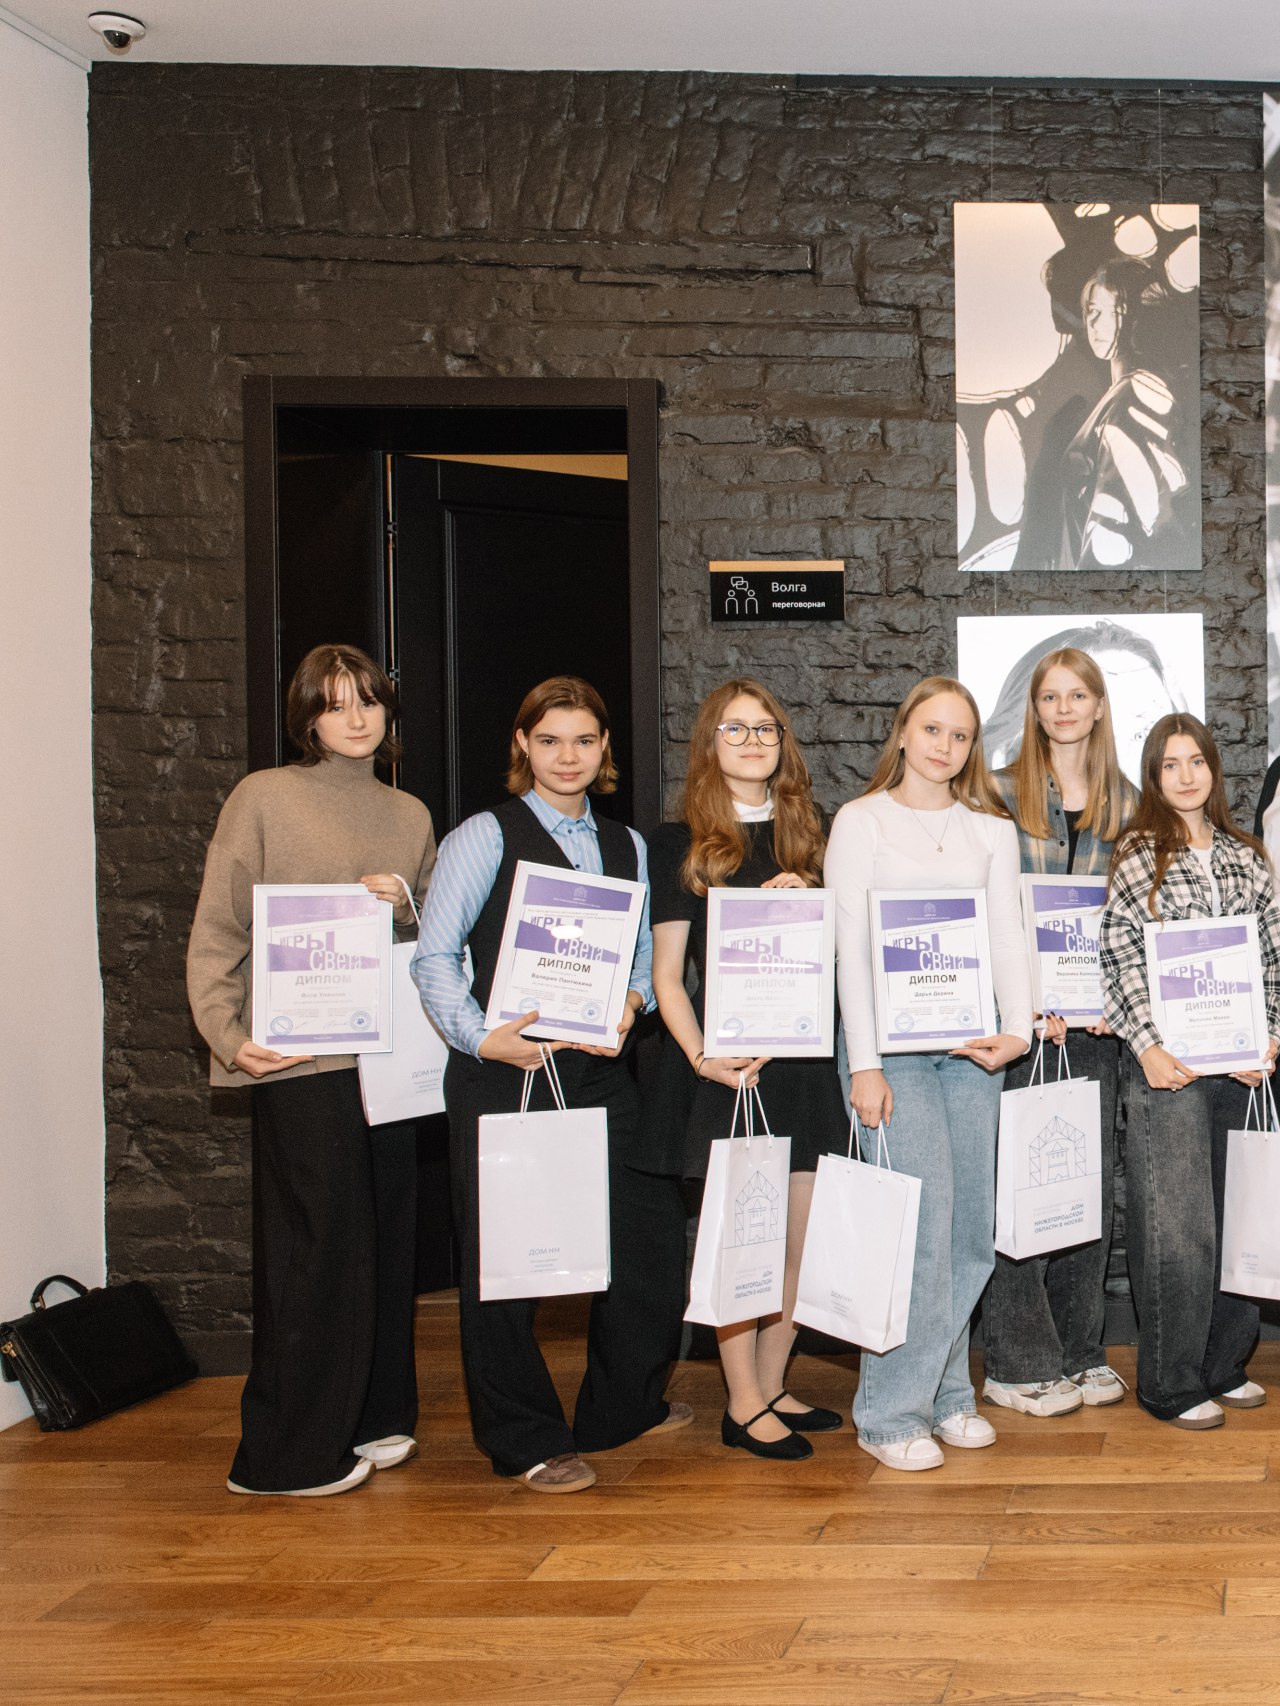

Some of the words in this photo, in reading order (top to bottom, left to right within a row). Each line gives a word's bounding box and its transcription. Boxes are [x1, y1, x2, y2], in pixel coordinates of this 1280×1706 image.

[771, 582, 807, 593] Волга
[772, 601, 826, 609] переговорная
[1042, 918, 1083, 936] ИГРЫ
[280, 931, 335, 951] ИГРЫ
[731, 936, 781, 955] ИГРЫ
[892, 933, 940, 953] ИГРЫ
[537, 957, 591, 974] ДИПЛОМ
[1057, 956, 1098, 966] ДИПЛОМ
[1168, 960, 1214, 980] ИГРЫ
[295, 975, 352, 986] ДИПЛОМ
[744, 978, 796, 989] ДИПЛОМ
[909, 974, 957, 986] ДИПЛОМ
[1184, 999, 1231, 1012] ДИПЛОМ
[412, 1069, 430, 1078] ДОМ
[529, 1248, 547, 1256] ДОМ
